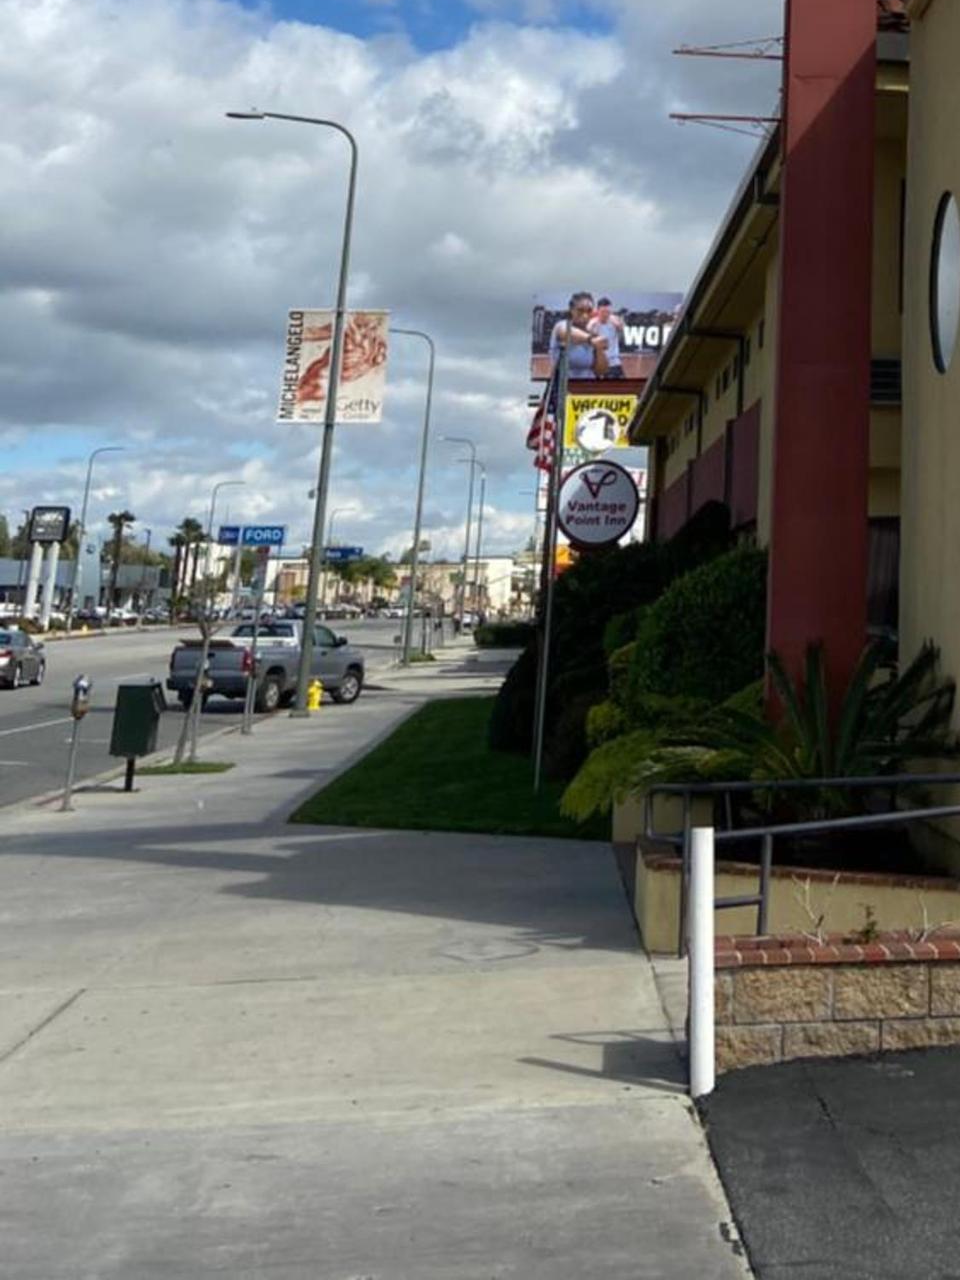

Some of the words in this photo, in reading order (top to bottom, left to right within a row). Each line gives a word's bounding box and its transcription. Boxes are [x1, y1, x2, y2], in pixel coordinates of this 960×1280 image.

[279, 310, 305, 419] MICHELANGELO
[567, 500, 627, 514] Vantage
[566, 515, 600, 526] Point
[604, 515, 627, 525] Inn
[245, 528, 282, 541] FORD
